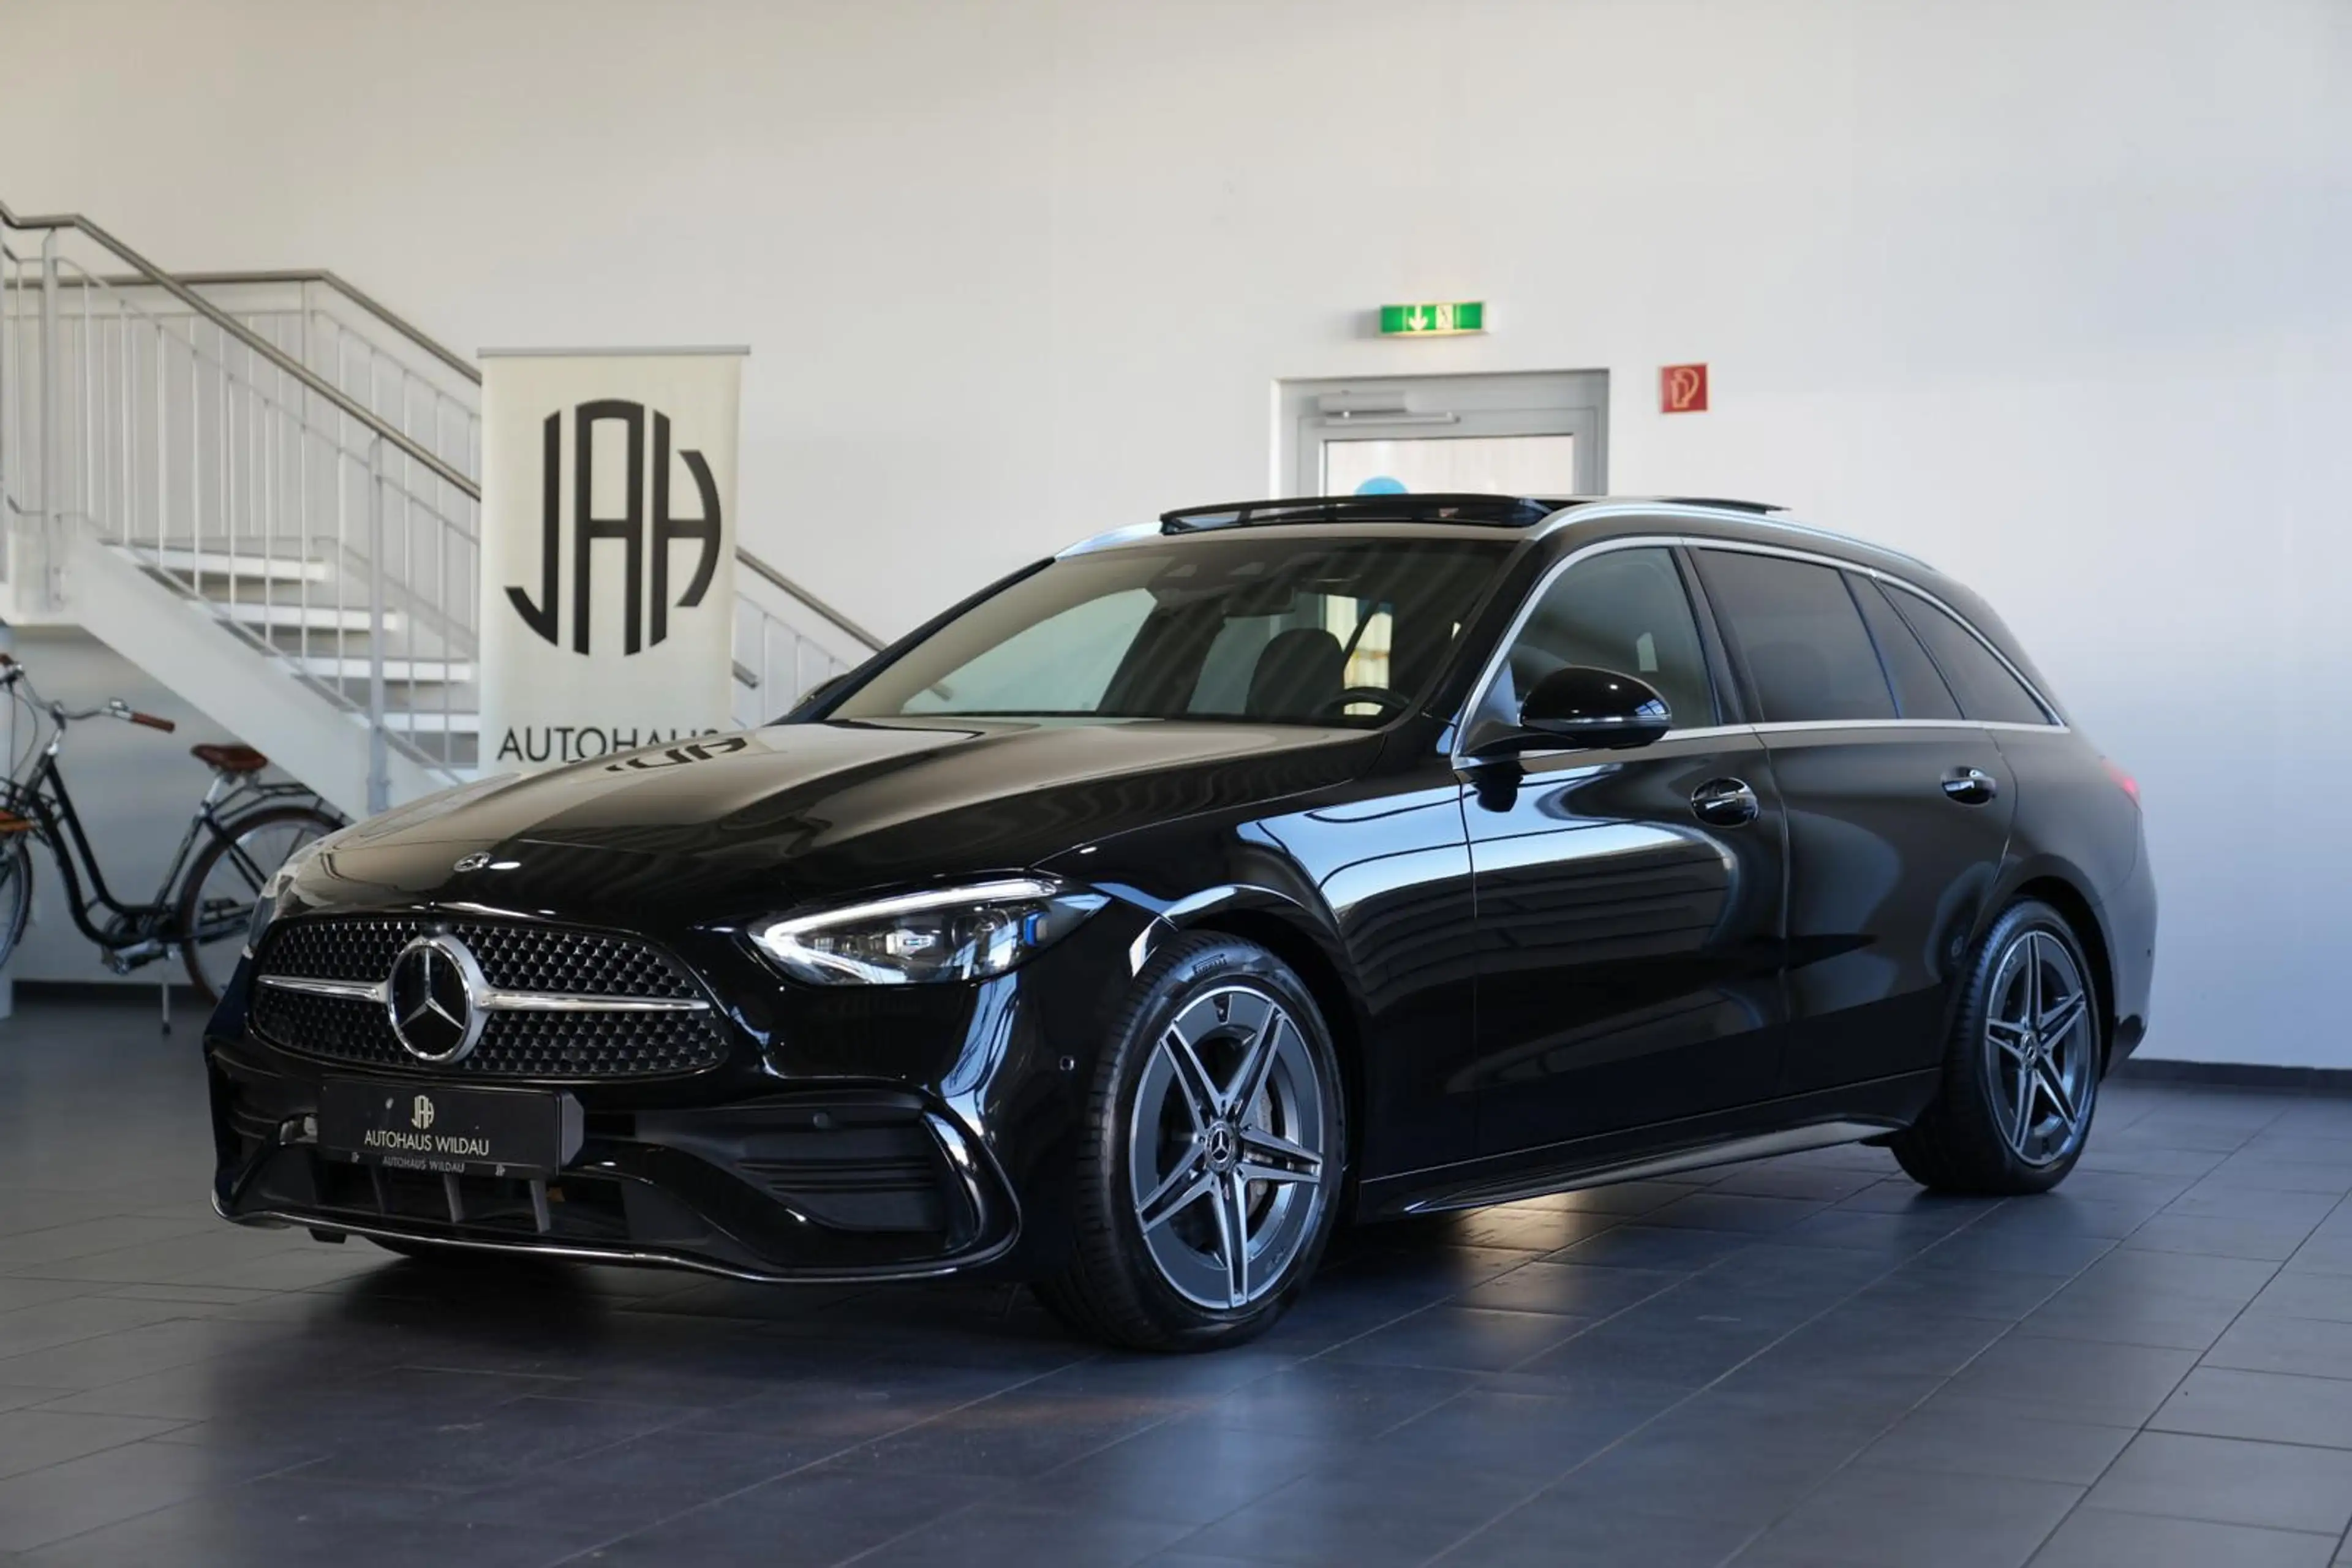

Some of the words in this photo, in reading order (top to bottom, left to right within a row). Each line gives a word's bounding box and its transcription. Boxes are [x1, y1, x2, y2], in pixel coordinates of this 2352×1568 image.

[497, 726, 718, 763] AUTOH
[364, 1129, 432, 1152] AUTOHAUS
[435, 1135, 489, 1156] WILDAU
[383, 1156, 426, 1170] AUTOHAUS
[429, 1160, 465, 1174] WILDAU
